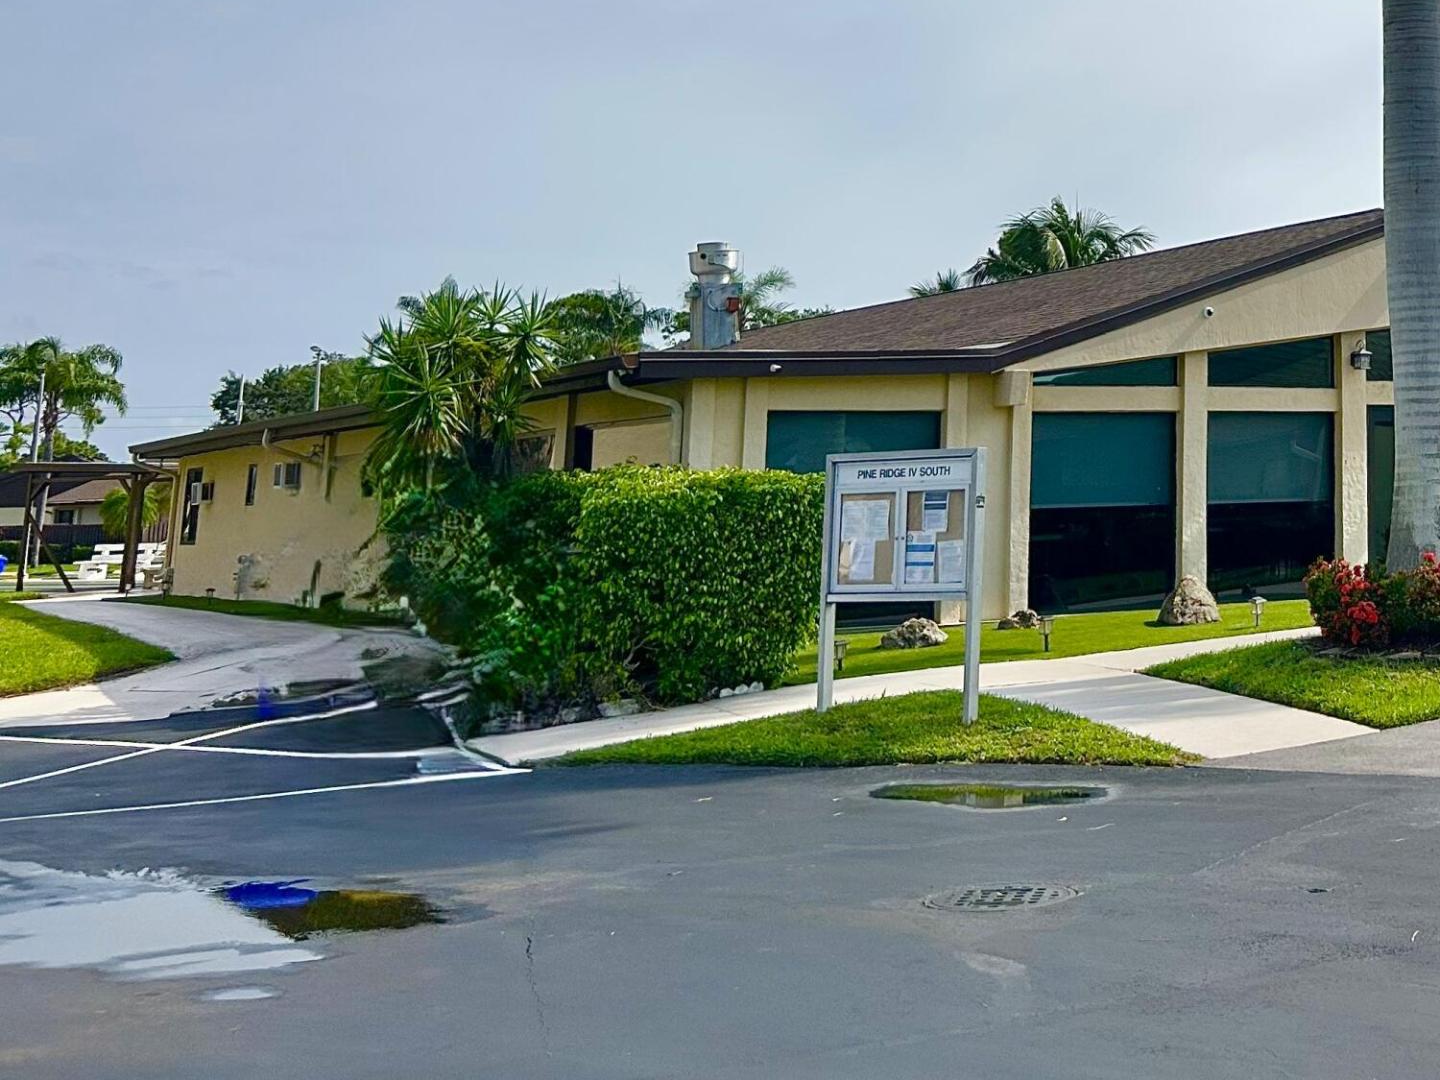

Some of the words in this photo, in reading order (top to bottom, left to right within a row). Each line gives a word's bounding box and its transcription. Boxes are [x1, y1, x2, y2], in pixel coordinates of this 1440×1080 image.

[857, 469, 877, 479] PINE
[880, 468, 906, 478] RIDGE
[908, 467, 917, 477] IV
[920, 466, 951, 477] SOUTH
